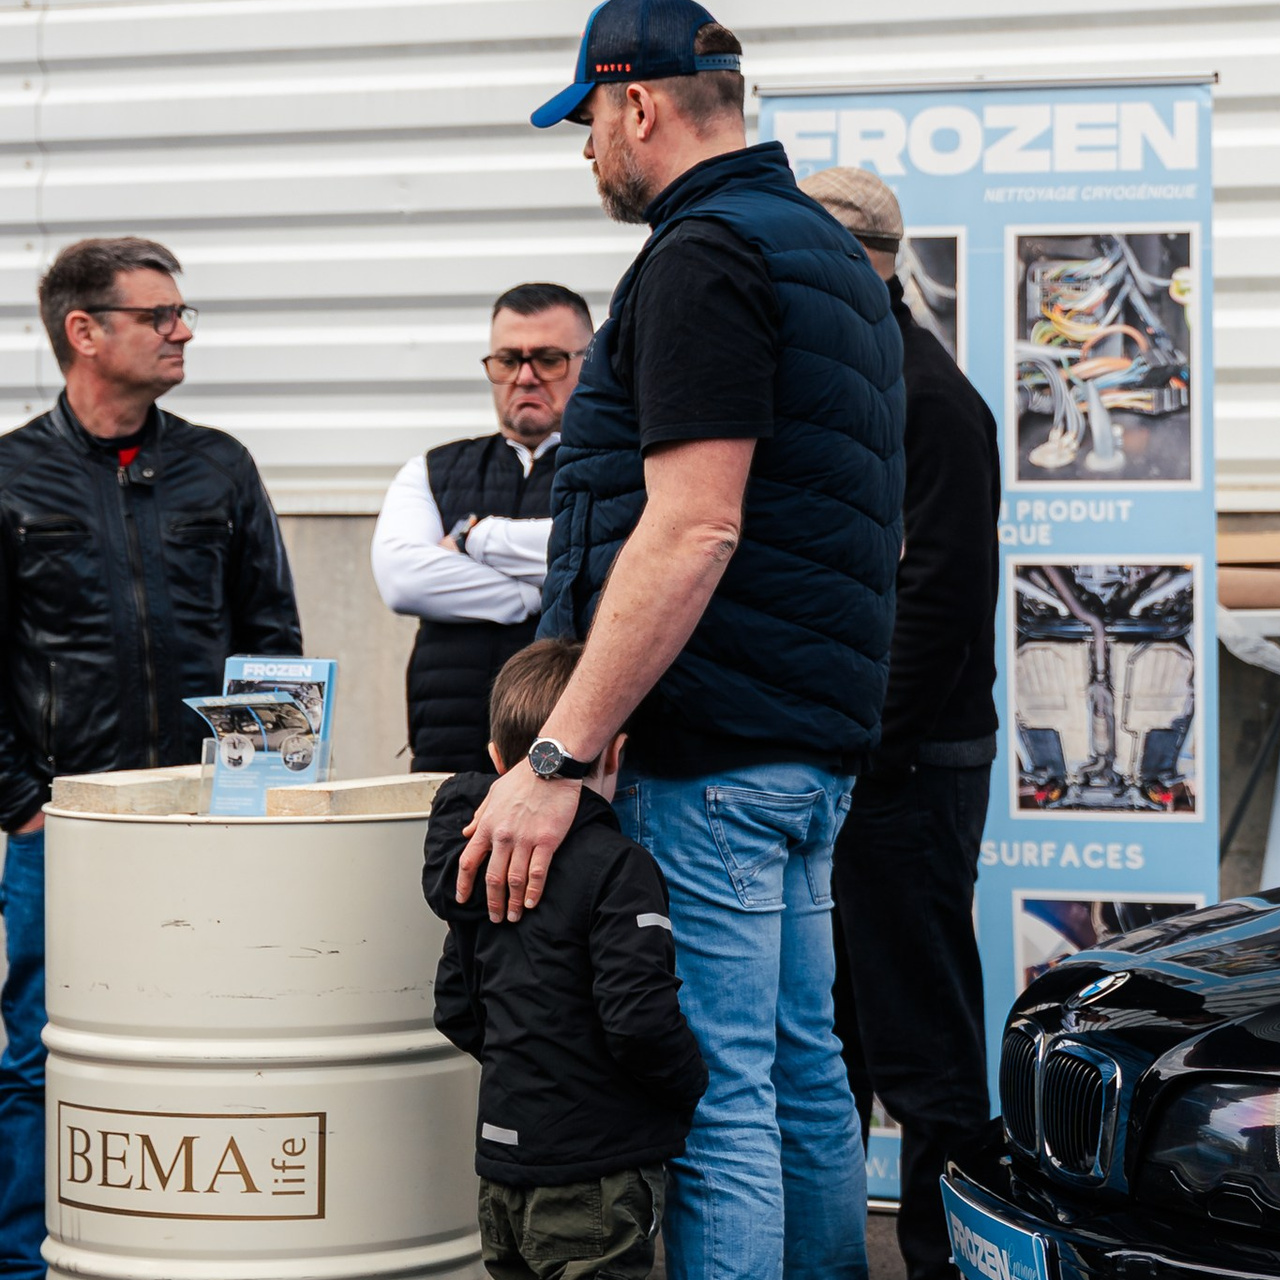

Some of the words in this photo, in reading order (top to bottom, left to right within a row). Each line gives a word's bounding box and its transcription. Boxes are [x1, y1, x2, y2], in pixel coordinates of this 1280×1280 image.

[595, 63, 631, 73] WATTS
[773, 102, 1198, 175] FROZEN
[983, 186, 1078, 203] NETTOYAGE
[1016, 499, 1133, 523] PRODUIT
[998, 523, 1053, 546] QUE
[242, 663, 312, 677] FROZEN
[979, 839, 1146, 870] SURFACES
[66, 1124, 263, 1195] BEMA
[271, 1136, 307, 1196] life
